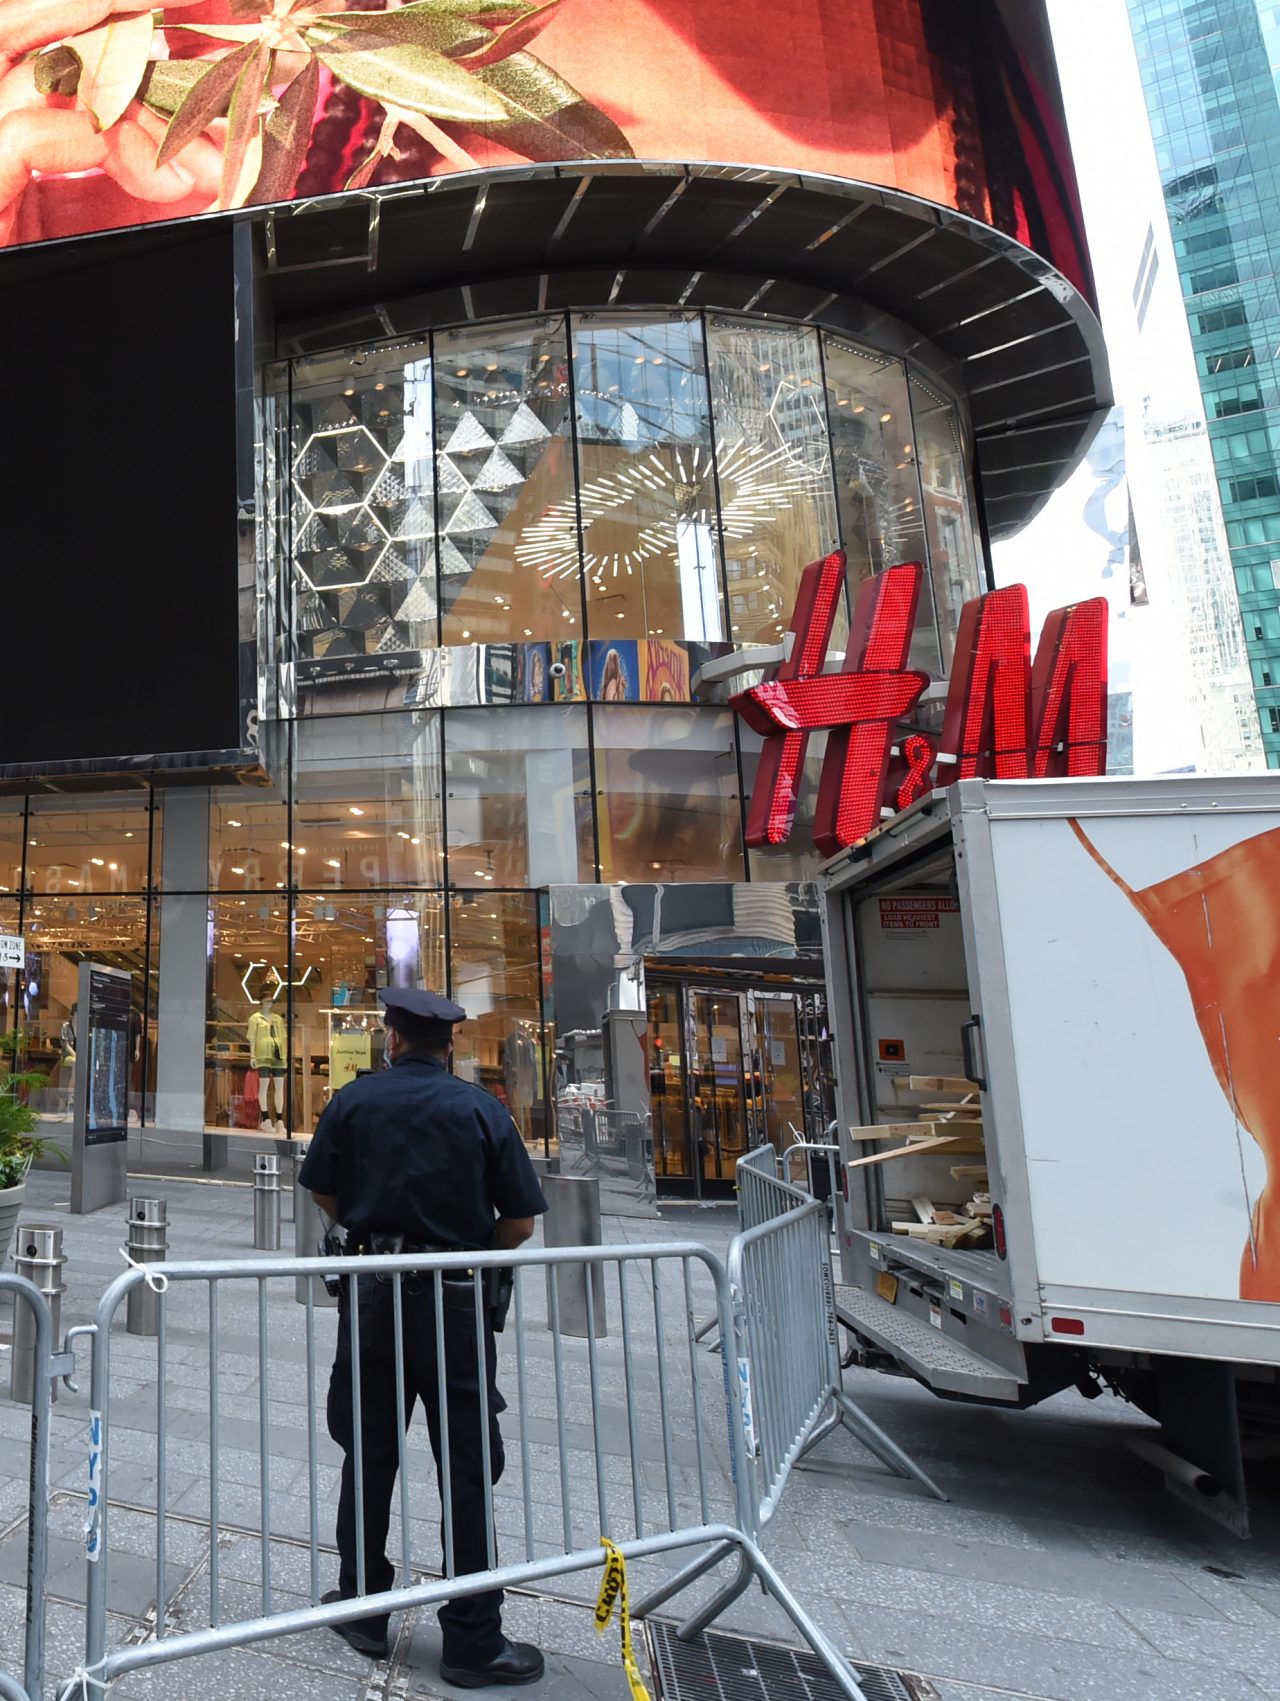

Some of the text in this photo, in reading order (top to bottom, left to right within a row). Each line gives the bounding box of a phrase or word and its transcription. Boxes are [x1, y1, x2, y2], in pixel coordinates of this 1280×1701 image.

[729, 549, 1110, 856] H&M
[881, 900, 956, 910] NO PASSENGERS ALLO
[9, 940, 22, 951] ZONE
